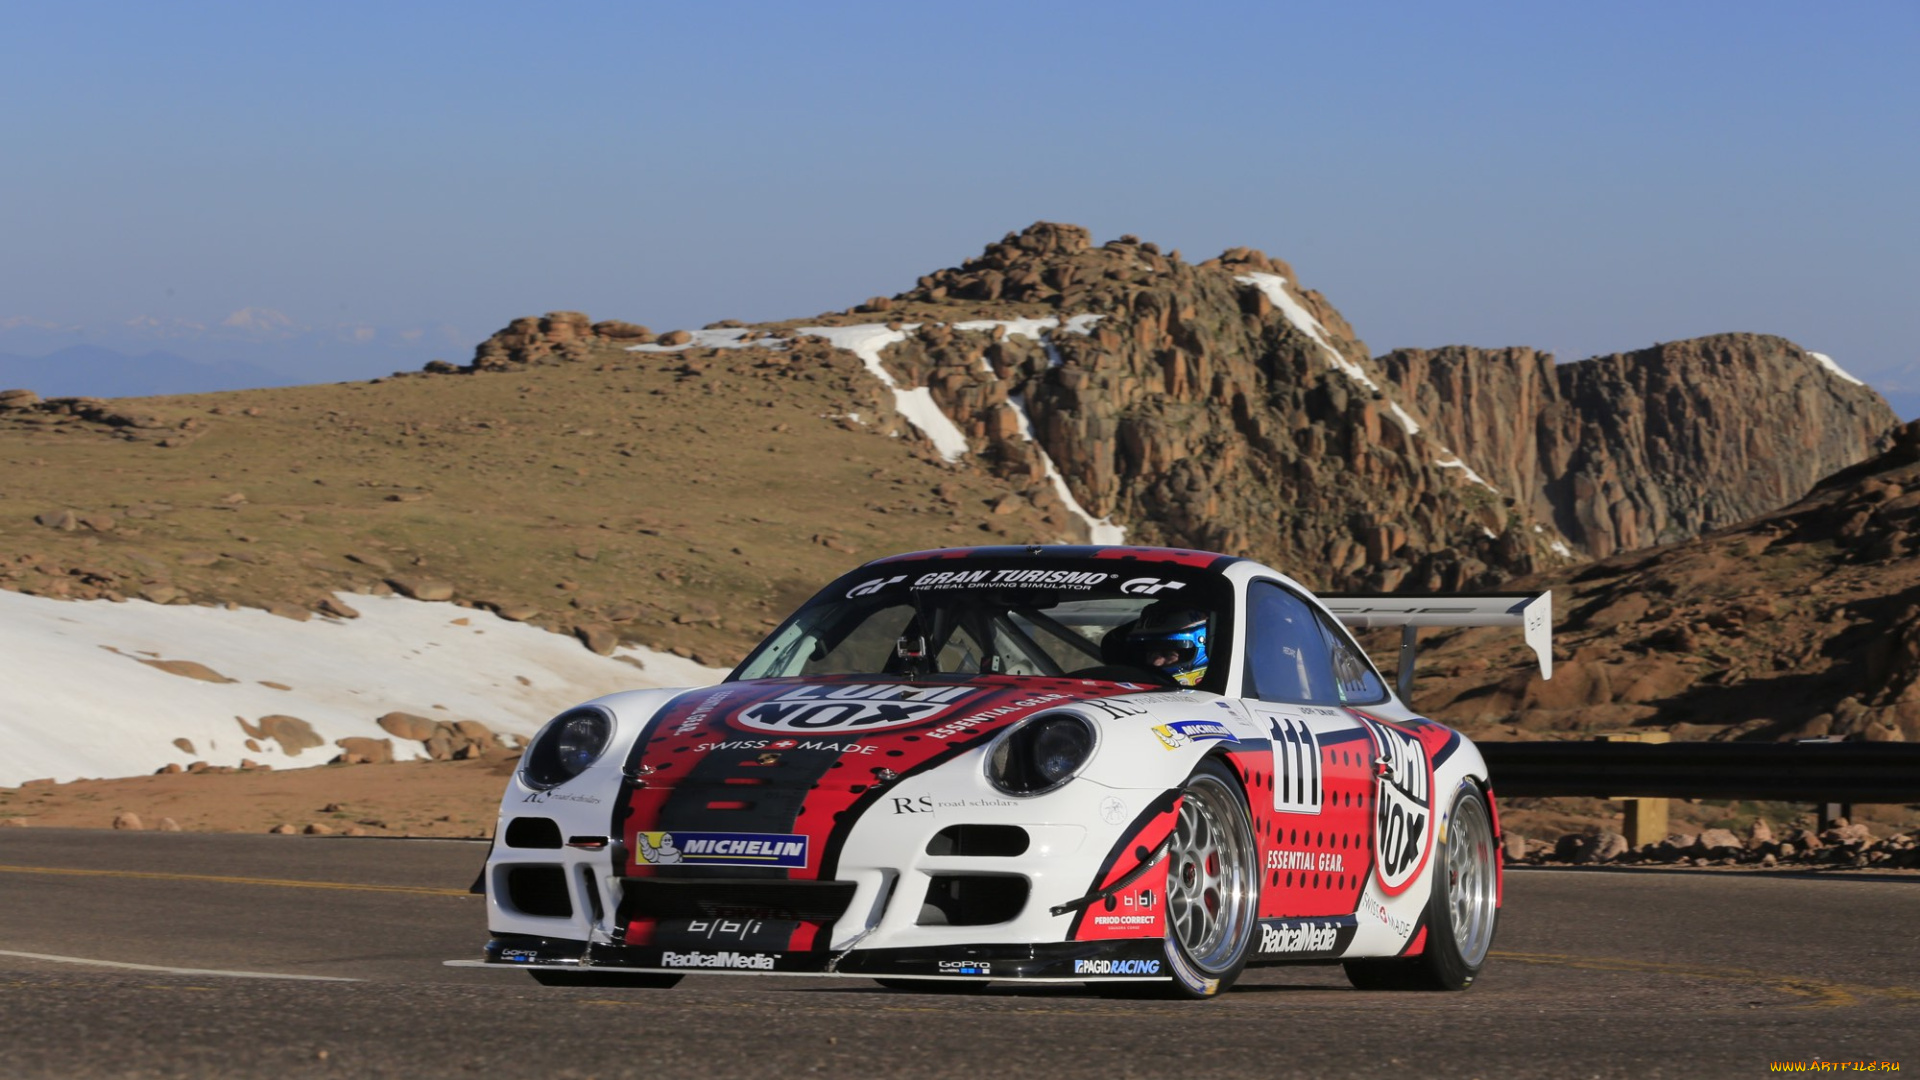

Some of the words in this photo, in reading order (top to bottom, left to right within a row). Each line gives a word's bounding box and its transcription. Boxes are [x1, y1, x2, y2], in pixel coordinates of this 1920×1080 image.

[914, 571, 991, 585] GRAN
[991, 569, 1108, 585] TURISMO
[933, 583, 965, 591] REAL
[968, 582, 1017, 590] DRIVING
[1020, 582, 1092, 591] SIMULATOR
[746, 703, 942, 728] NOX
[926, 705, 1023, 740] ESSENTIAL
[1181, 724, 1231, 736] MICHELIN
[692, 739, 770, 753] SWISS
[797, 740, 879, 756] MADE
[1269, 716, 1318, 806] 111
[890, 795, 934, 815] RS
[938, 798, 966, 808] road
[969, 798, 1019, 808] scholars
[1378, 779, 1426, 878] NOX
[683, 839, 804, 857] MICHELIN
[1267, 850, 1315, 871] ESSENTIAL
[1318, 852, 1345, 873] GEAR.
[1094, 916, 1120, 925] PERIOD
[1120, 915, 1155, 925] CORRECT
[938, 960, 991, 968] GoPro
